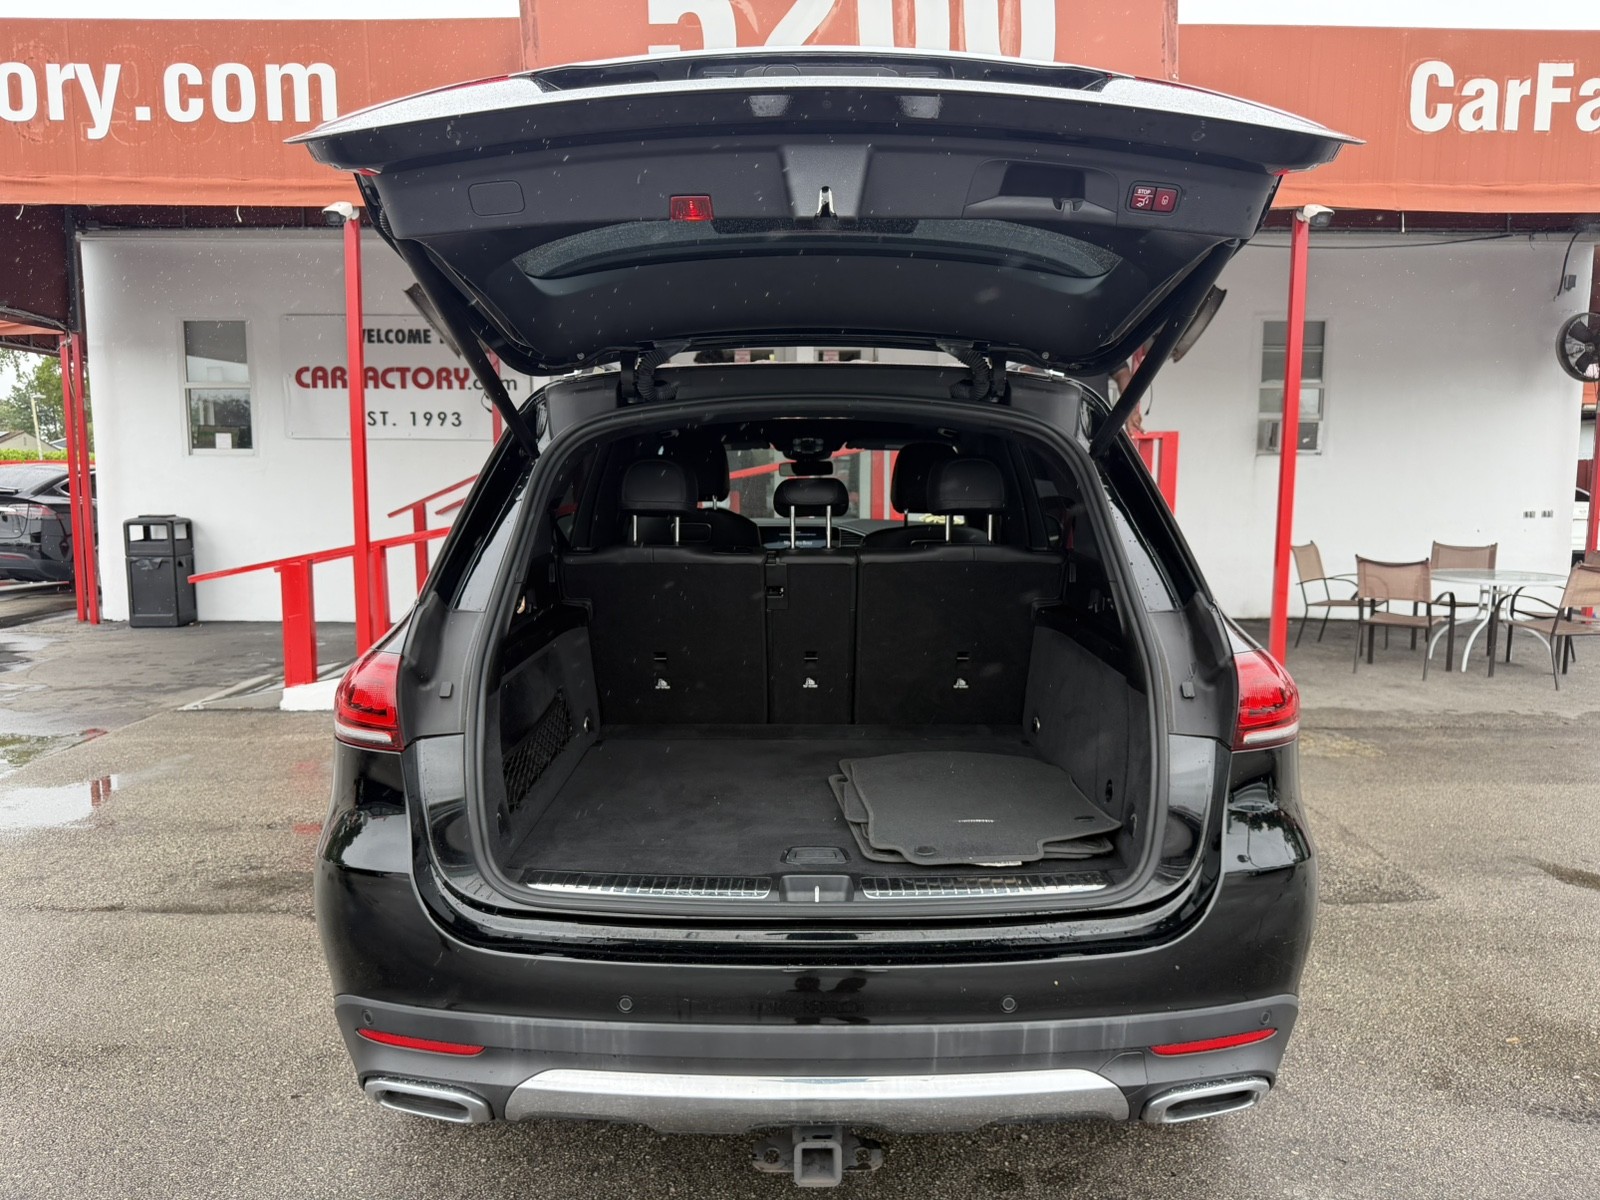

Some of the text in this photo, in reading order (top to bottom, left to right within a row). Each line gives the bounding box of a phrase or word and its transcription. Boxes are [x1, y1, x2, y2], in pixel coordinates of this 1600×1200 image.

[0, 61, 338, 140] ory.com
[362, 328, 432, 344] ELCOME
[295, 366, 518, 391] CARACTORY.cm
[367, 411, 462, 427] ST. 1993
